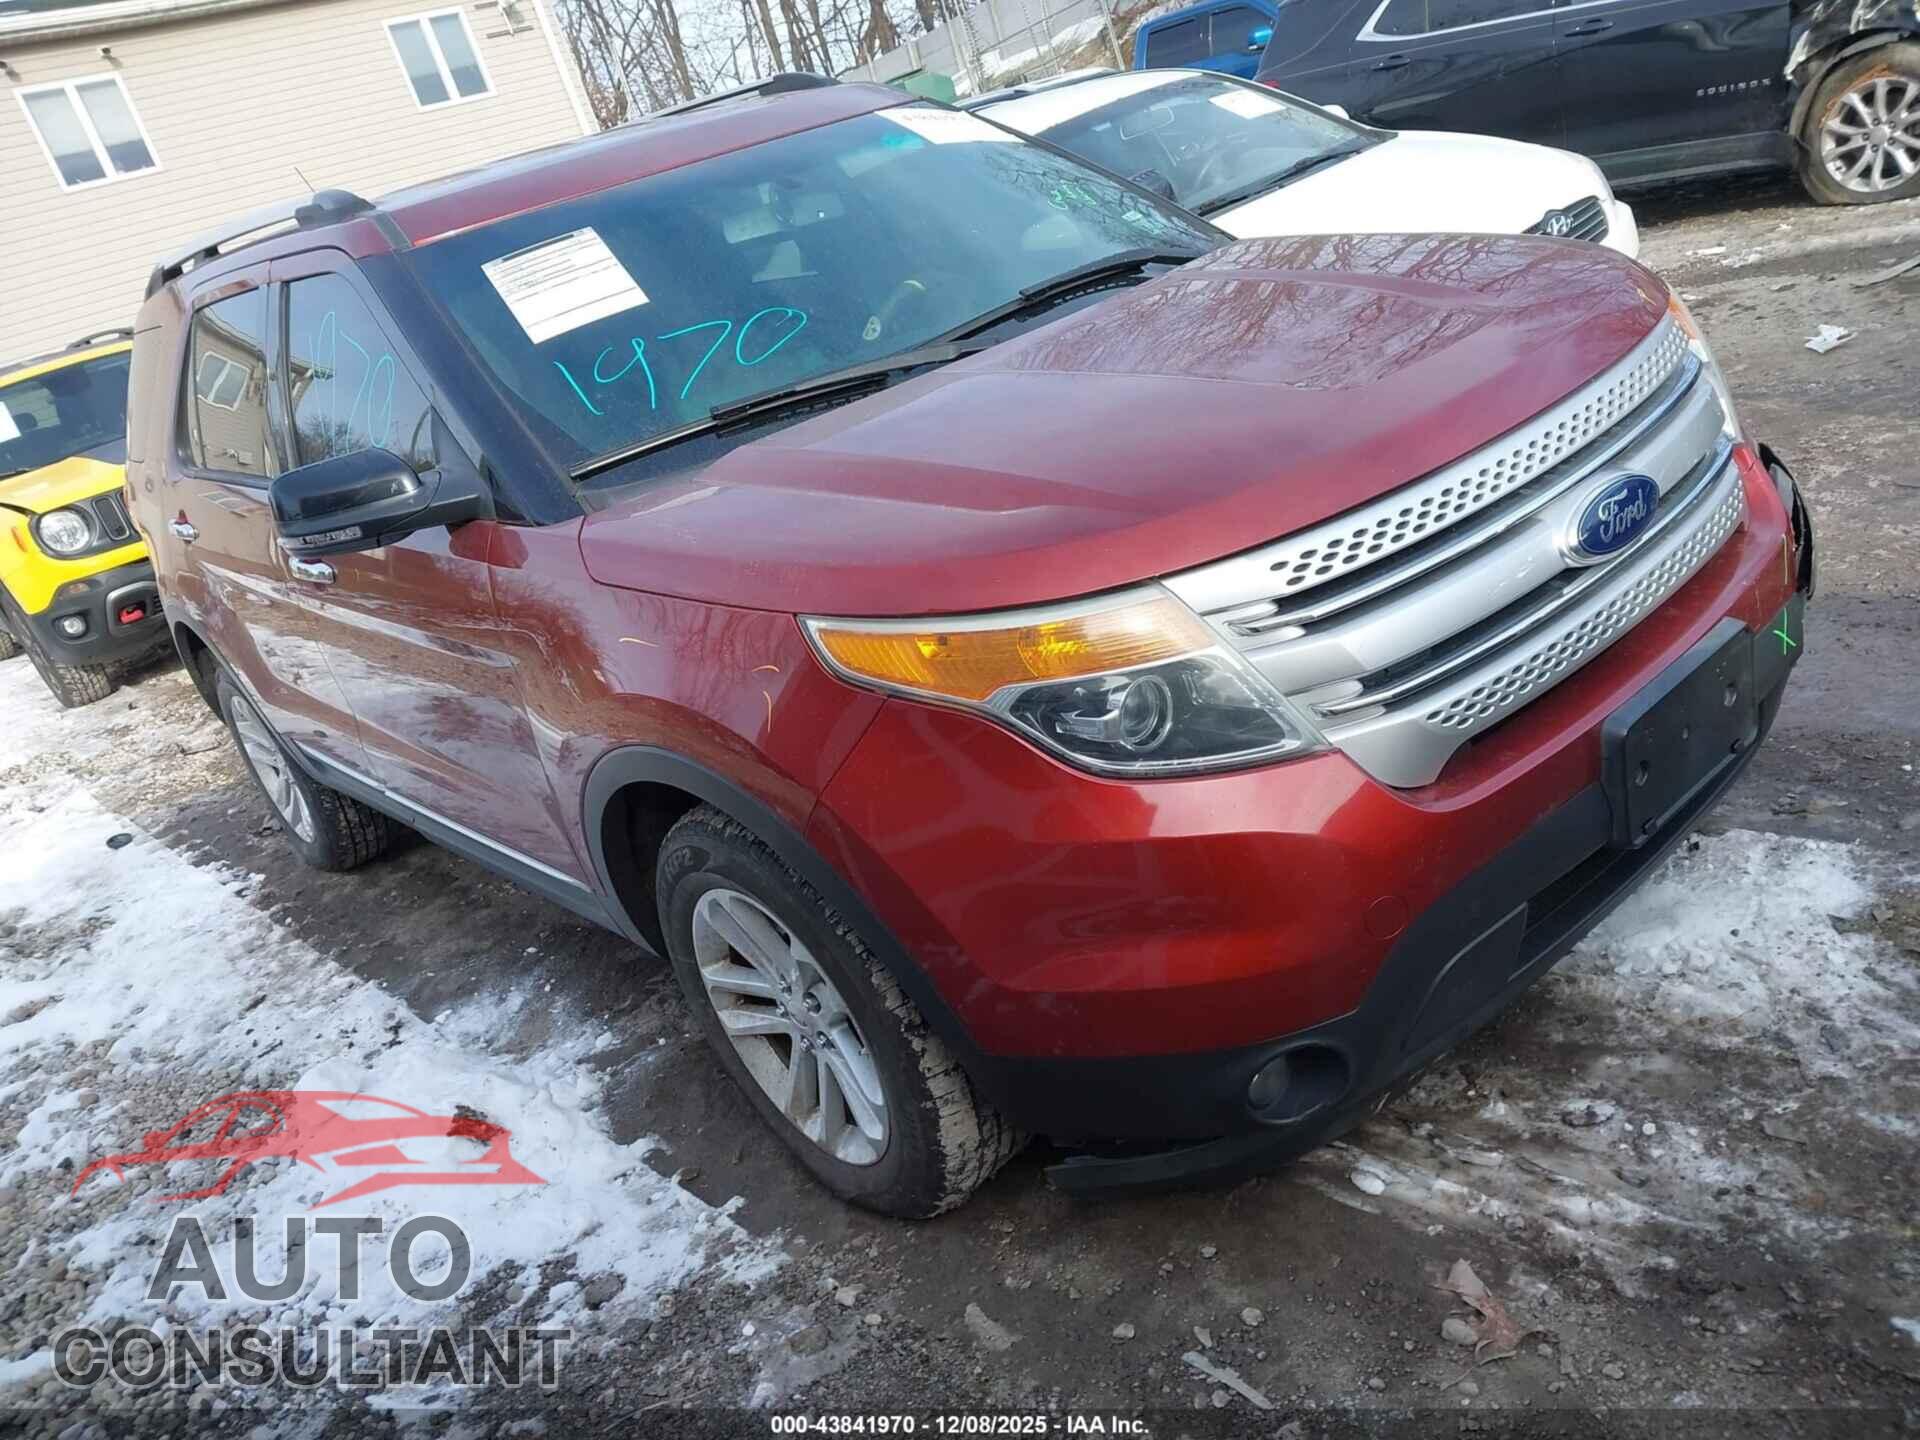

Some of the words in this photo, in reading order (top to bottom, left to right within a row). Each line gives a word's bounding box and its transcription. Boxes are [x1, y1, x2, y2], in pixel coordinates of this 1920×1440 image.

[1696, 78, 1771, 97] EQUINOX
[553, 307, 807, 416] 1970
[1599, 488, 1648, 543] Ford
